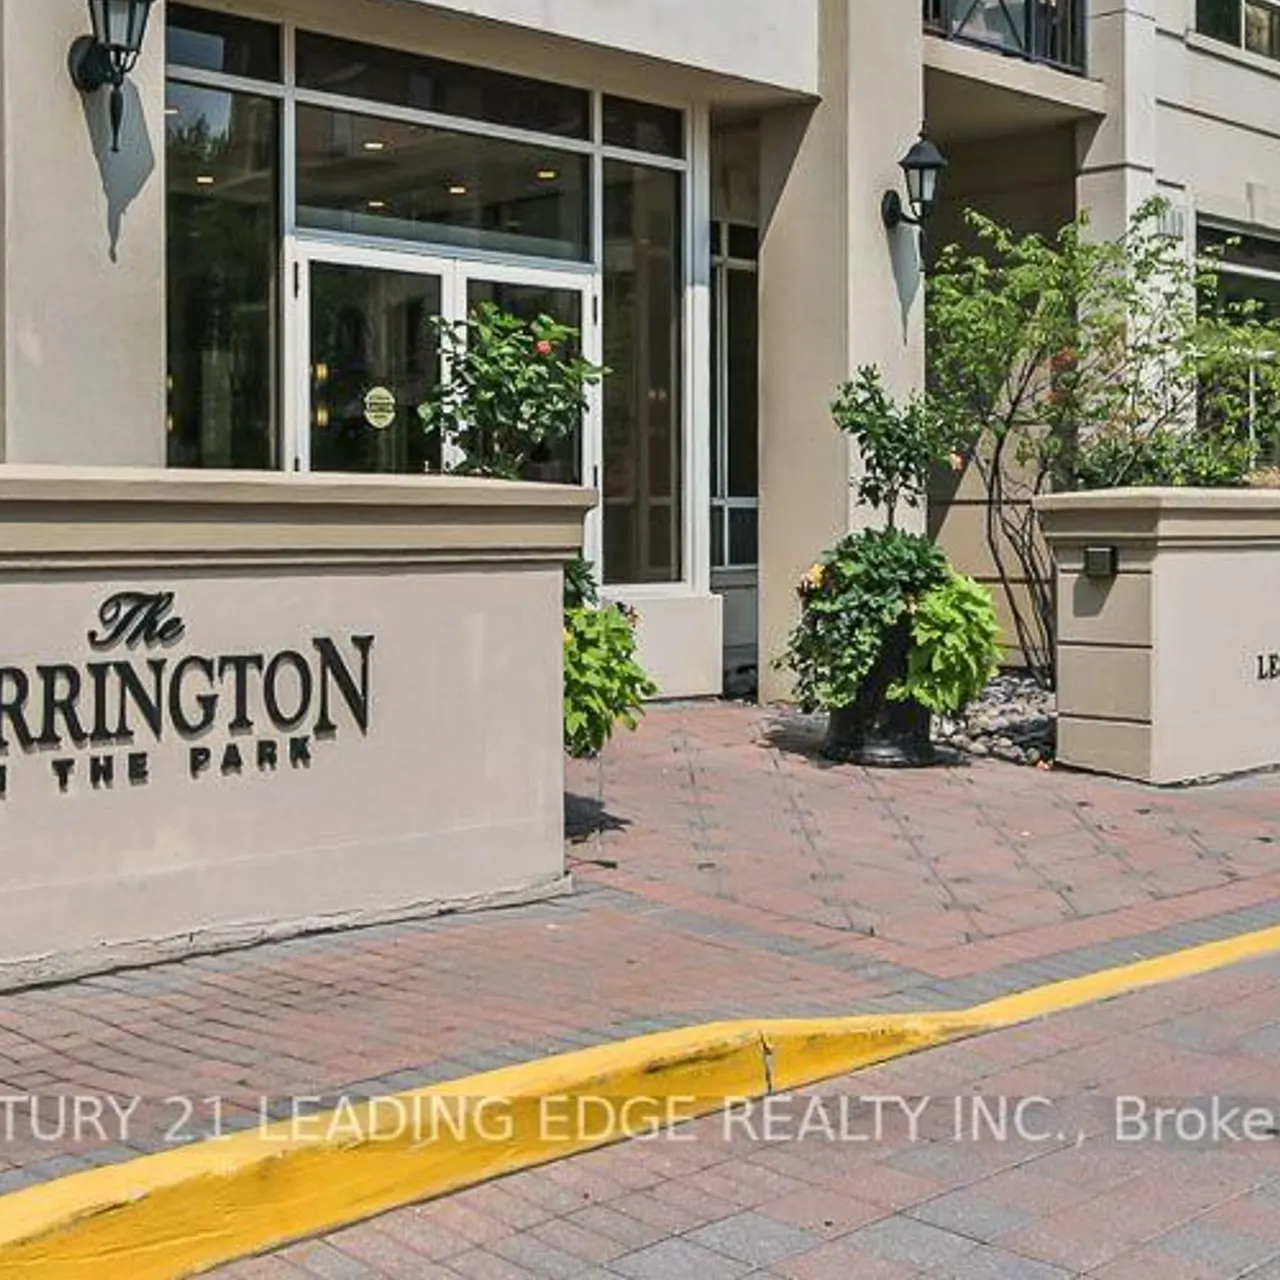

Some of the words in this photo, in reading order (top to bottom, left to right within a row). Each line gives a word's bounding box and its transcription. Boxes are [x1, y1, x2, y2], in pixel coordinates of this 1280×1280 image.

[88, 590, 186, 649] The
[51, 751, 149, 792] THE
[189, 735, 312, 779] PARK
